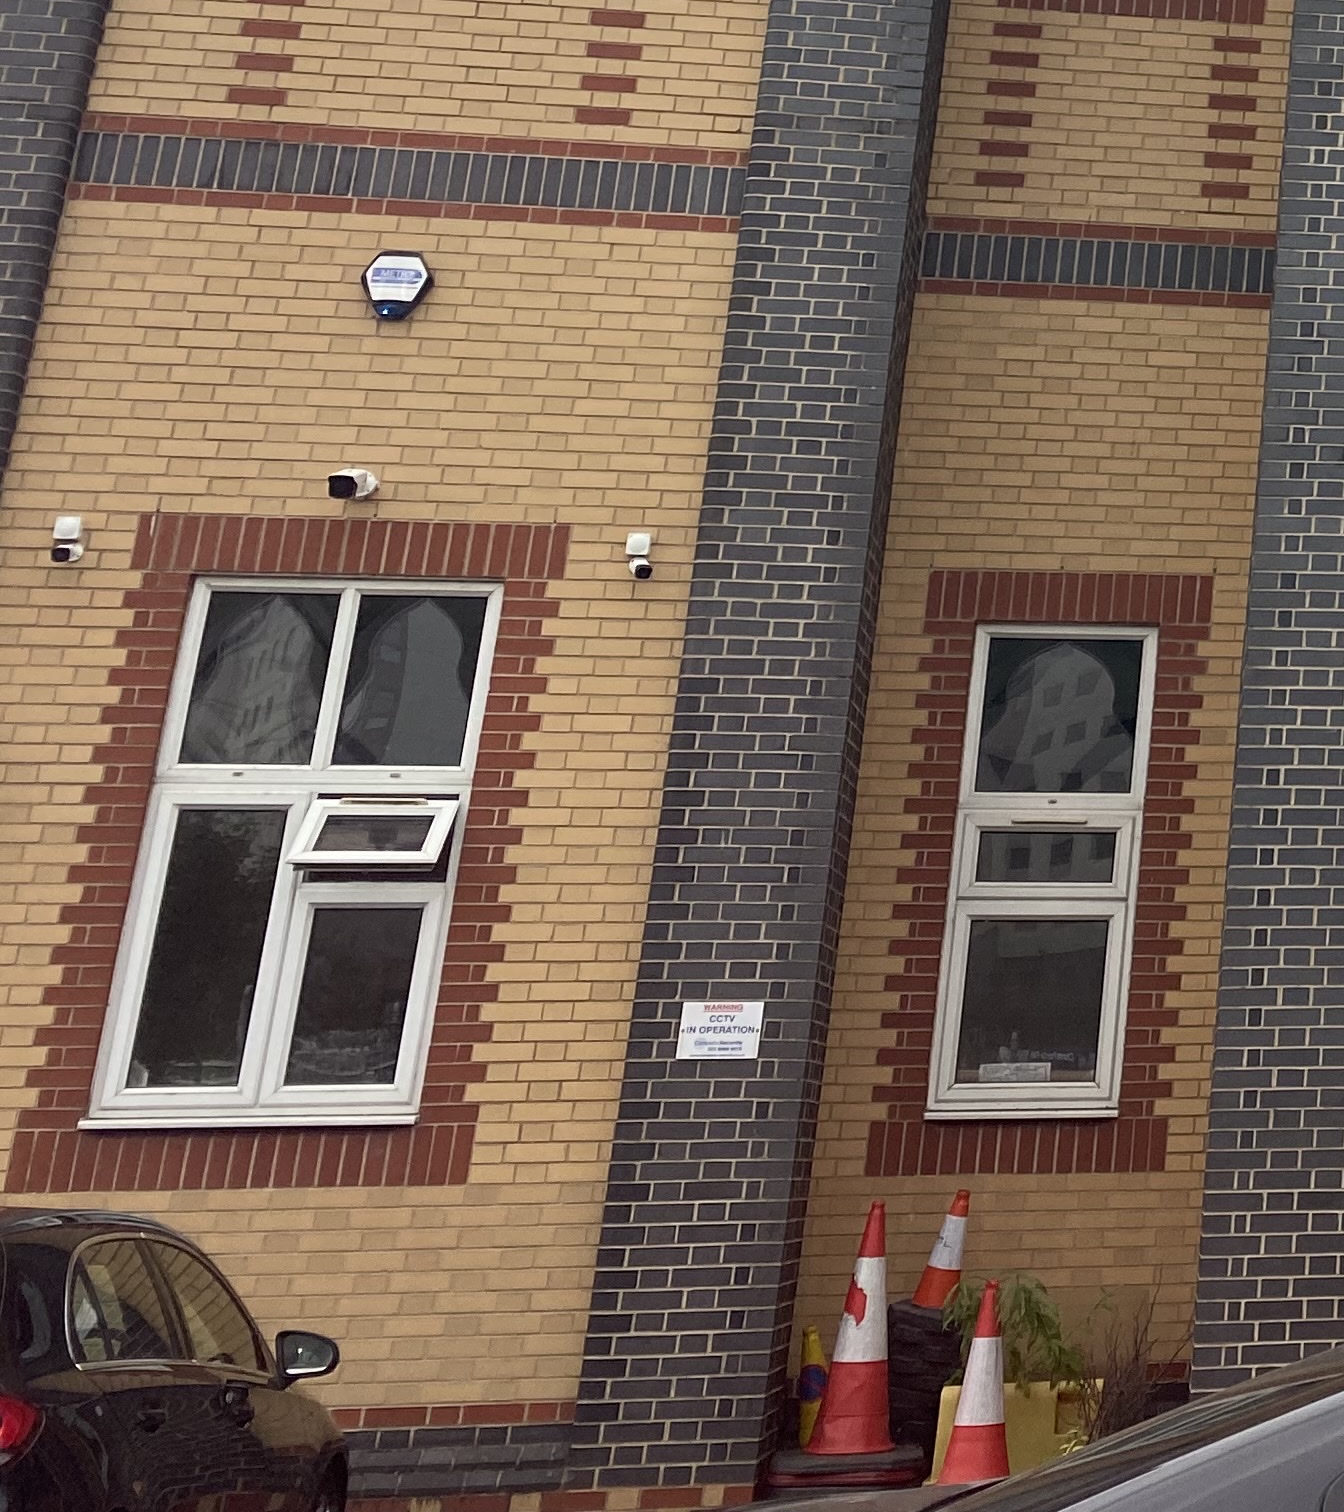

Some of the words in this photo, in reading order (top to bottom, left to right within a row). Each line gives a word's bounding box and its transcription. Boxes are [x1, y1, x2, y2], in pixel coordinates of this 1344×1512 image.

[704, 1003, 743, 1011] WARNING
[709, 1015, 736, 1023] CCTV
[686, 1025, 696, 1034] IN
[698, 1025, 755, 1034] OPERATION
